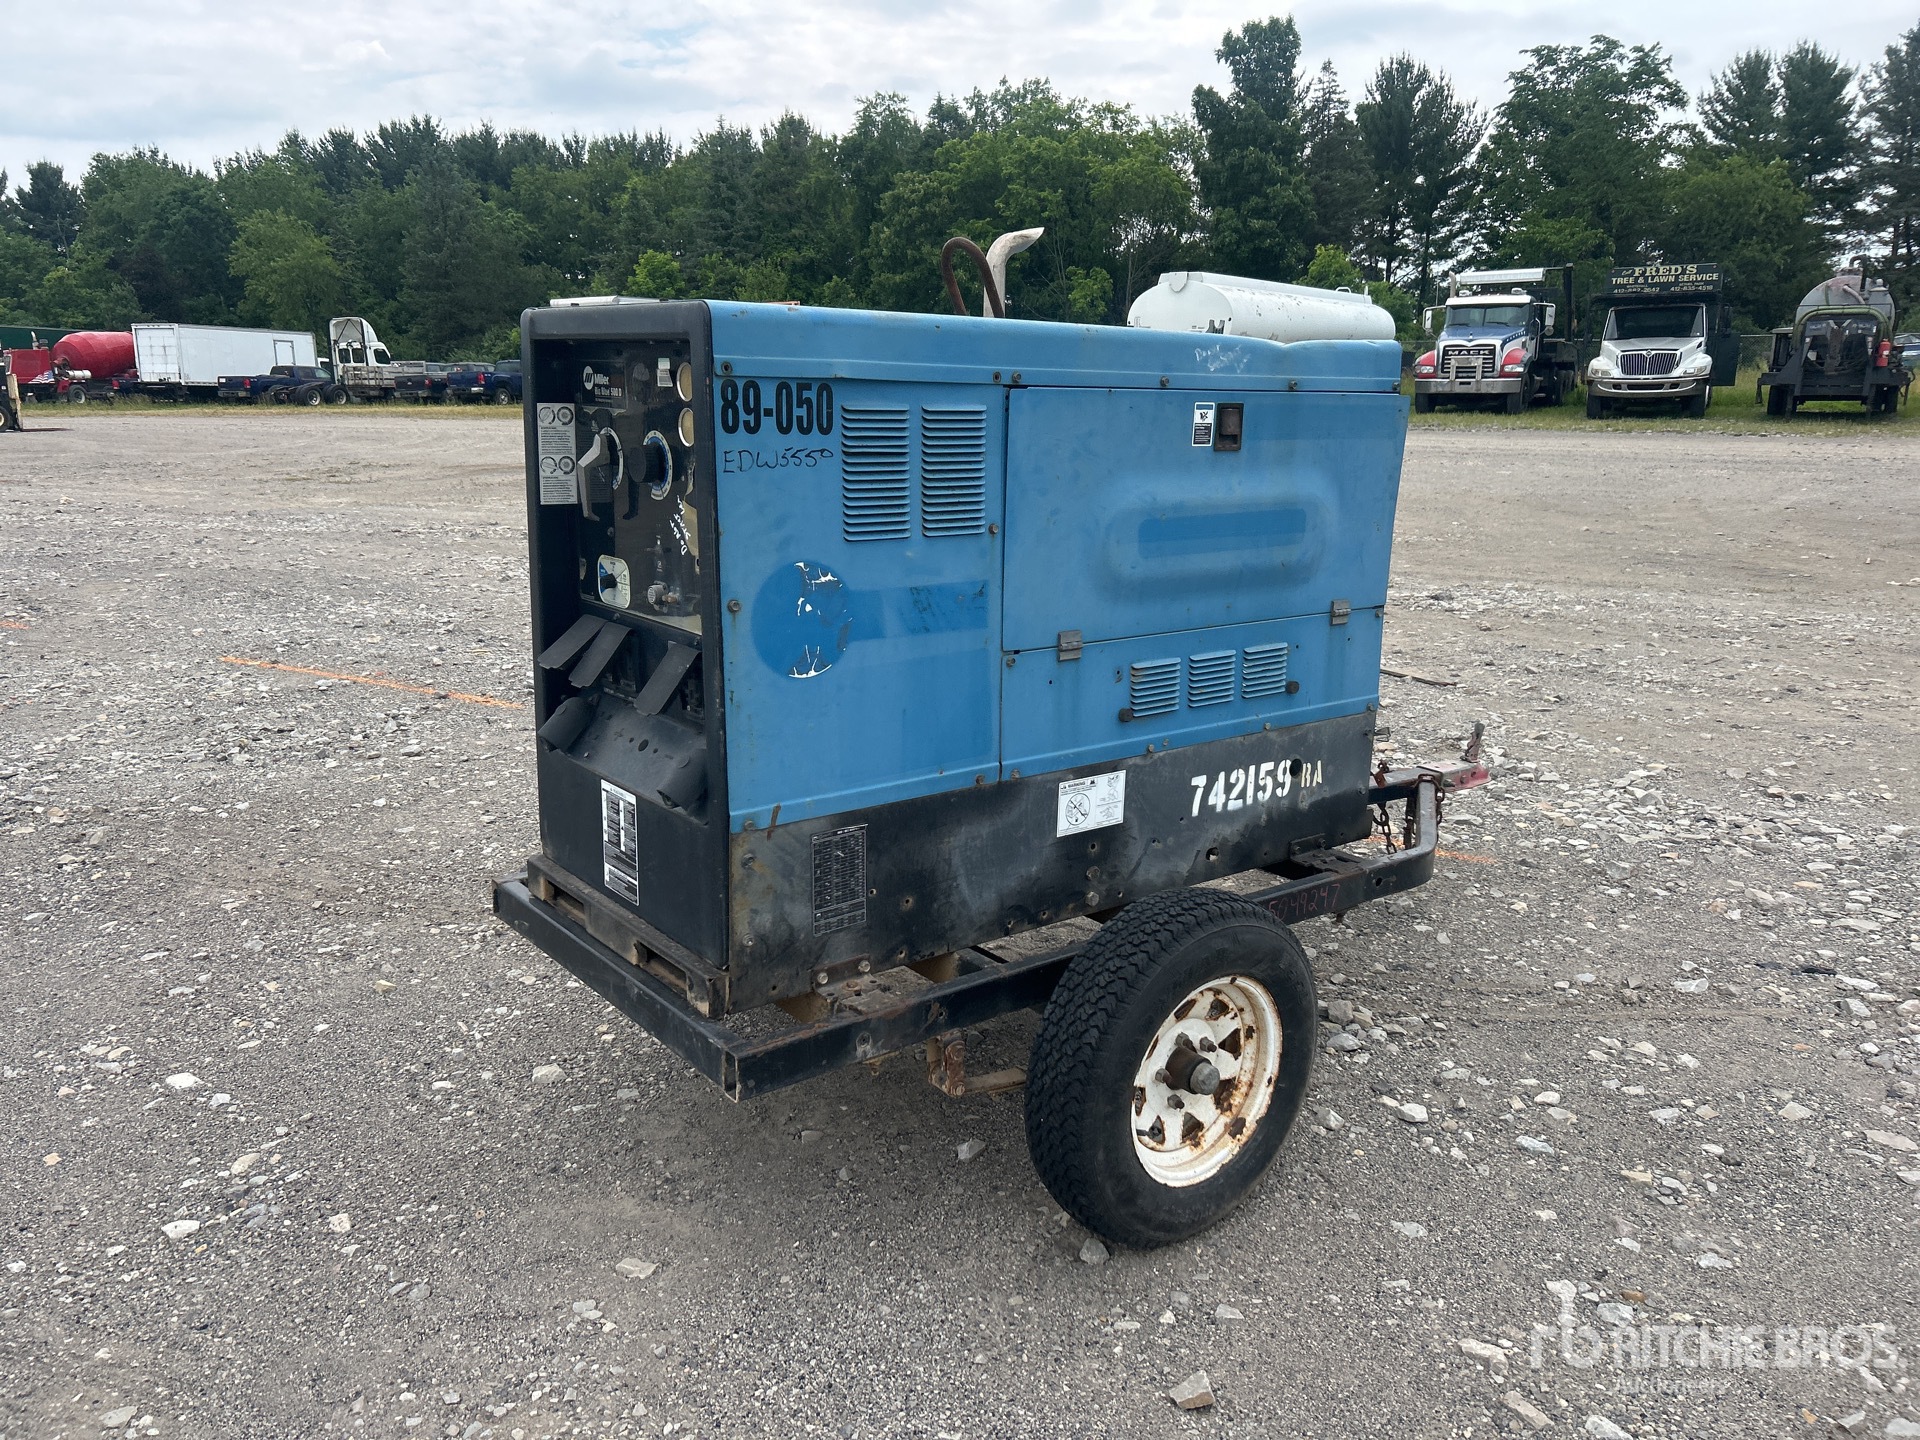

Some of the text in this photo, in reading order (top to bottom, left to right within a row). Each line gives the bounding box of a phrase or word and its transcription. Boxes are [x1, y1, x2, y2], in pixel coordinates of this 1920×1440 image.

[1633, 265, 1697, 276] FRED'S
[1611, 273, 1719, 285] TREE & LAWN SERVICE
[594, 374, 609, 385] Miller
[720, 379, 834, 436] 89-050
[1191, 759, 1292, 817] 742159
